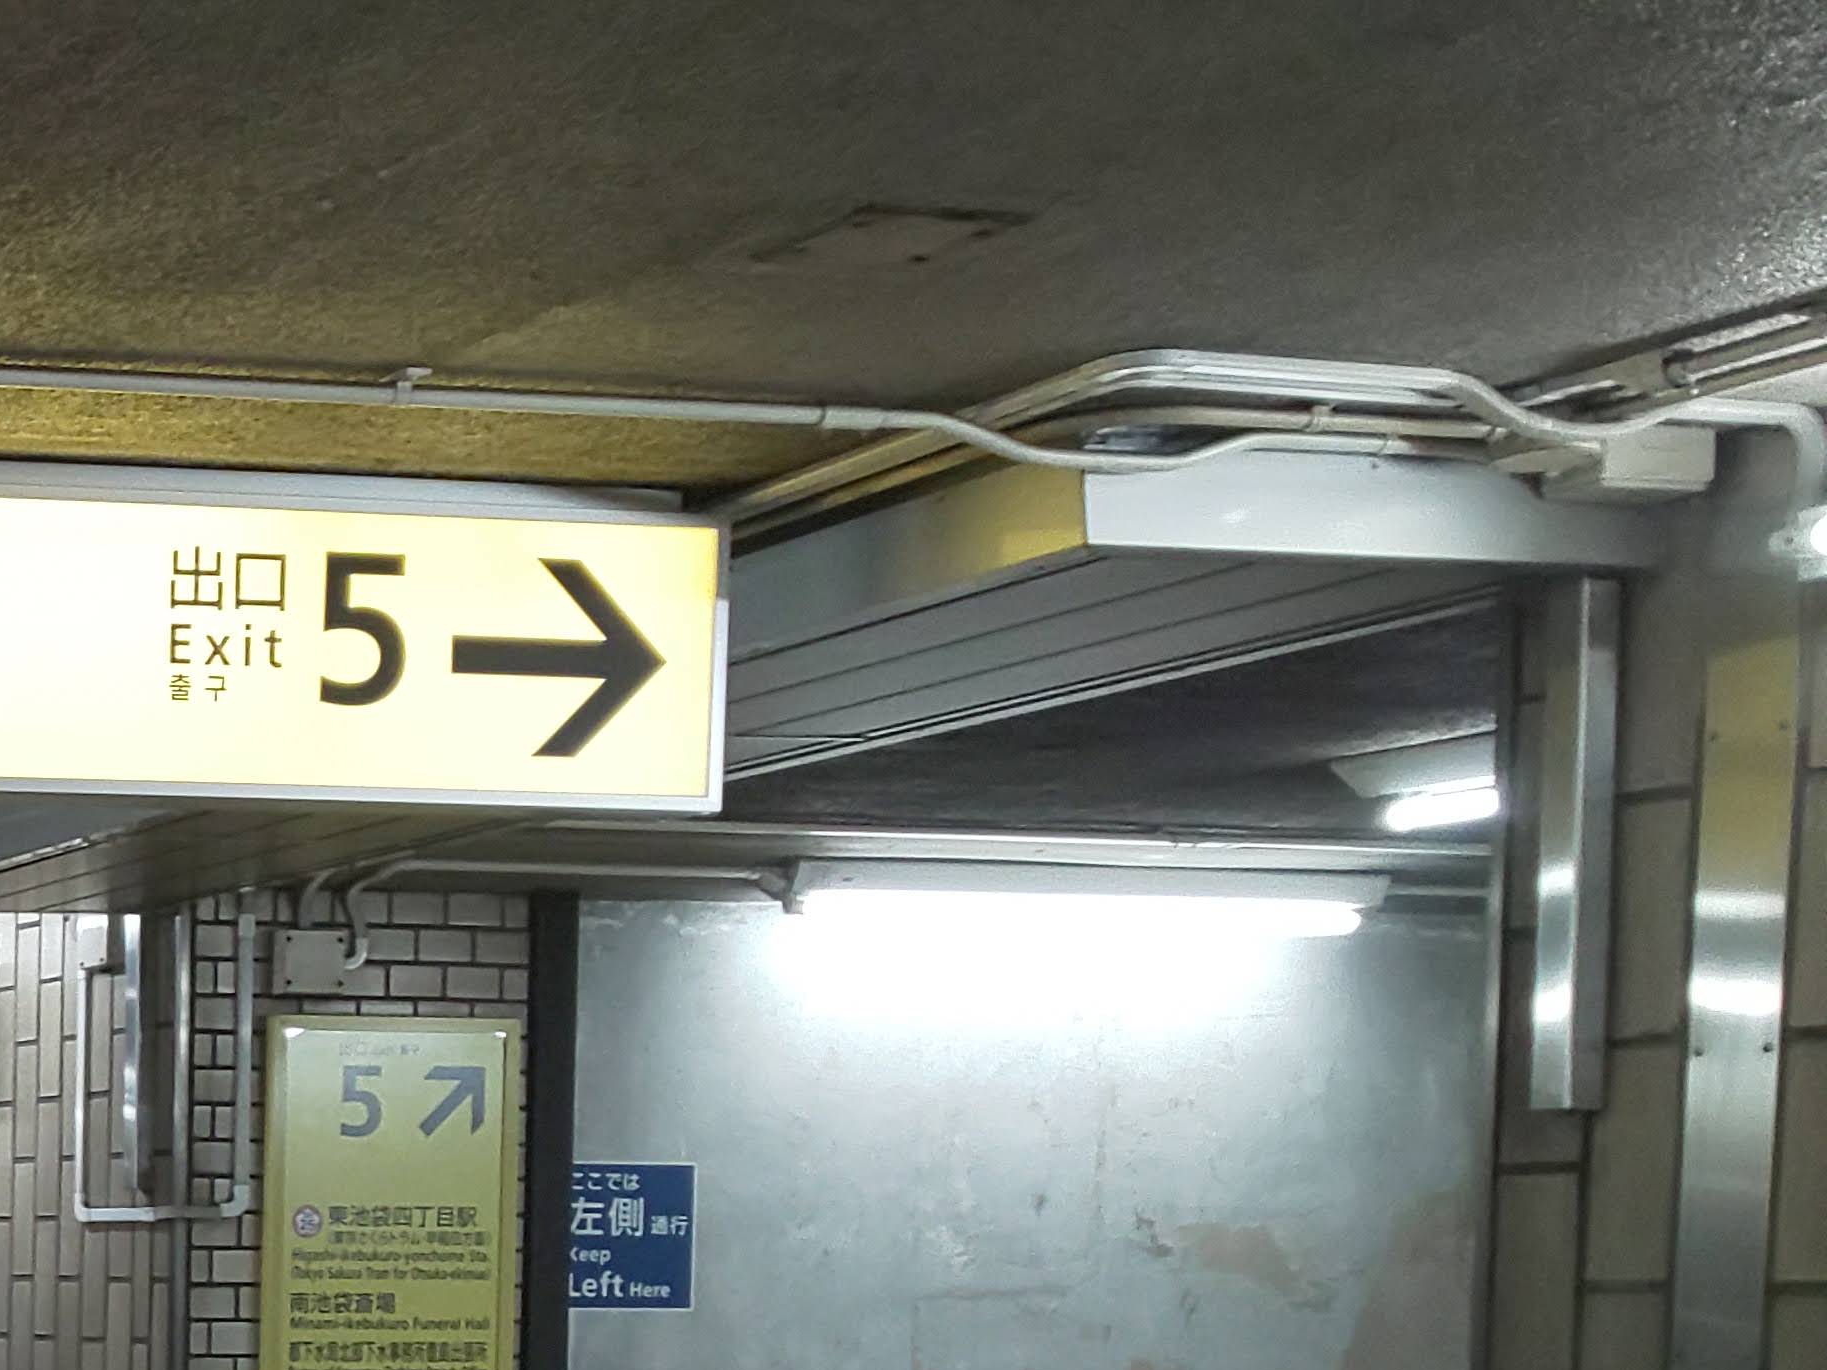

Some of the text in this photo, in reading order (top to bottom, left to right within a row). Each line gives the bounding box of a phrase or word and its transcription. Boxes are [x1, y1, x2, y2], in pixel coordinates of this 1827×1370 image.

[170, 546, 286, 611] 出口
[170, 624, 283, 668] Exit
[320, 551, 406, 706] 5
[339, 1065, 383, 1137] 5
[571, 1172, 641, 1191] ここでは
[328, 1205, 477, 1227] 東池袋四丁目駅
[570, 1197, 689, 1237] 左側 通行
[568, 1271, 672, 1298] Left Here
